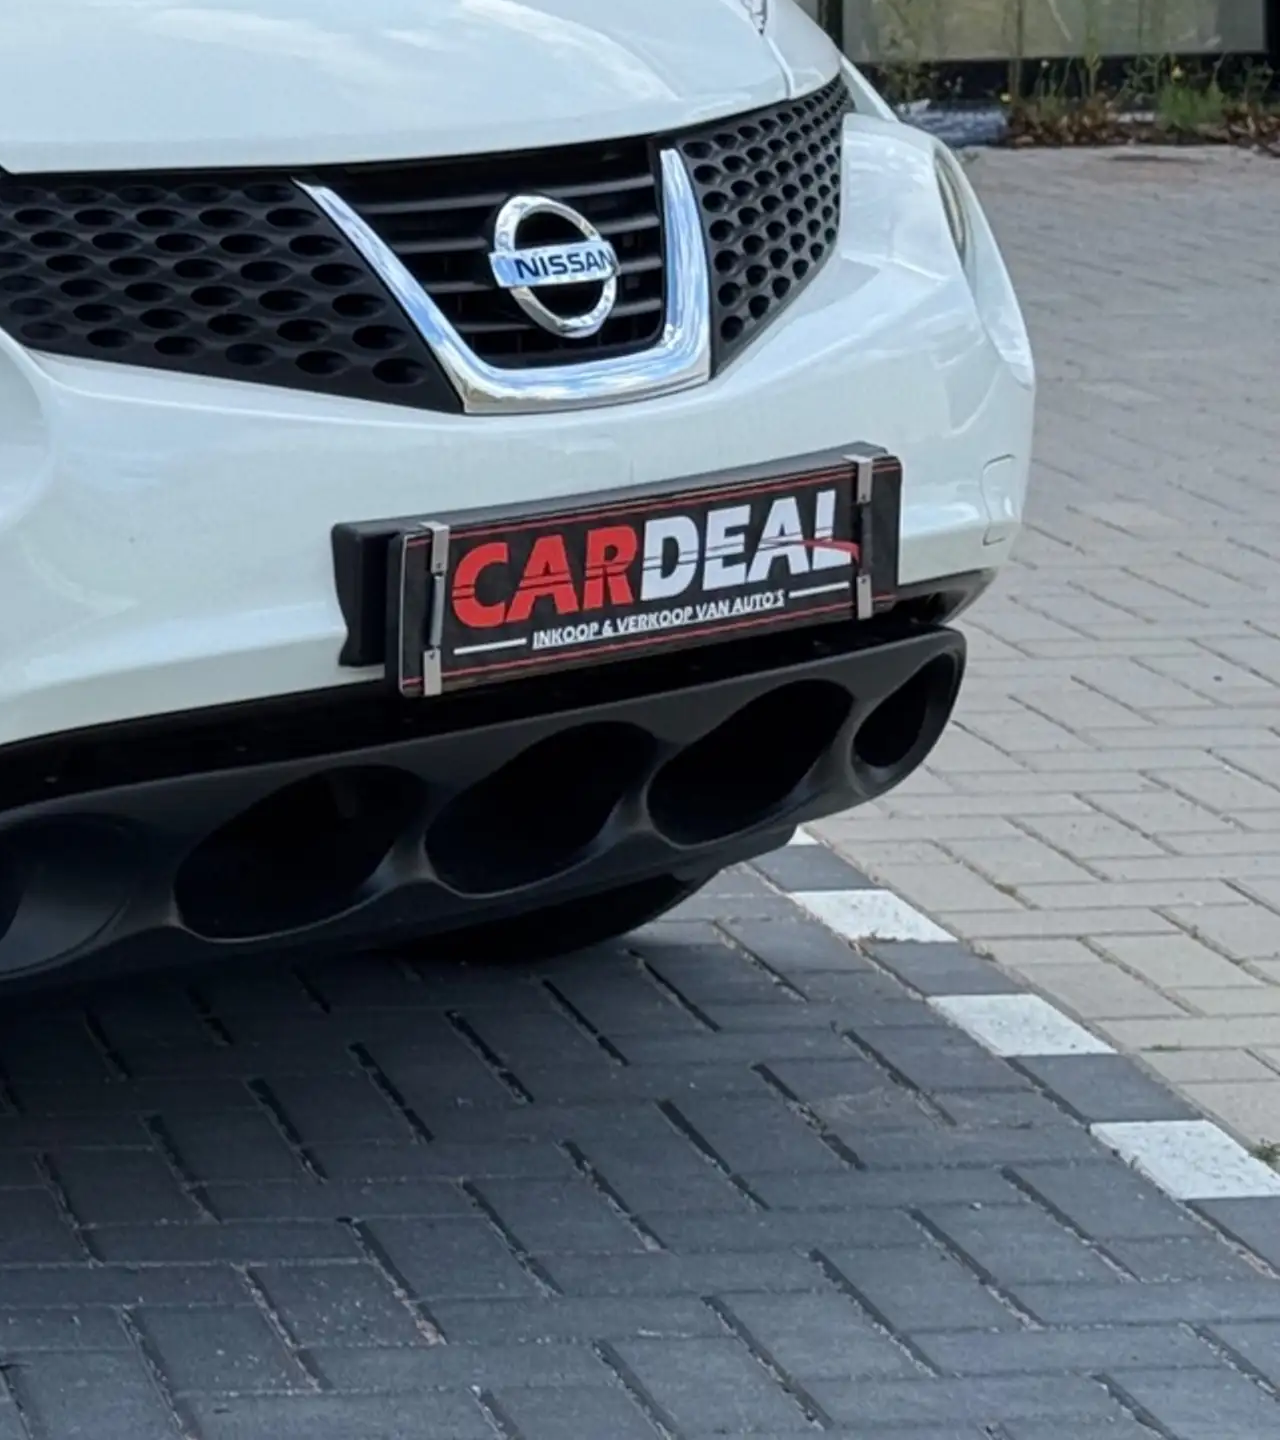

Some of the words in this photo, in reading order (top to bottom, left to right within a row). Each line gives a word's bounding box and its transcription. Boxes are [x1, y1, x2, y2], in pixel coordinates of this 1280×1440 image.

[513, 247, 615, 280] NISSAN
[451, 490, 852, 629] CARDEAL
[532, 621, 600, 650] INKOOP
[602, 619, 614, 636] &
[616, 605, 694, 635] VERKOOP
[695, 598, 730, 622] VAN
[731, 588, 785, 616] AUTO'S
